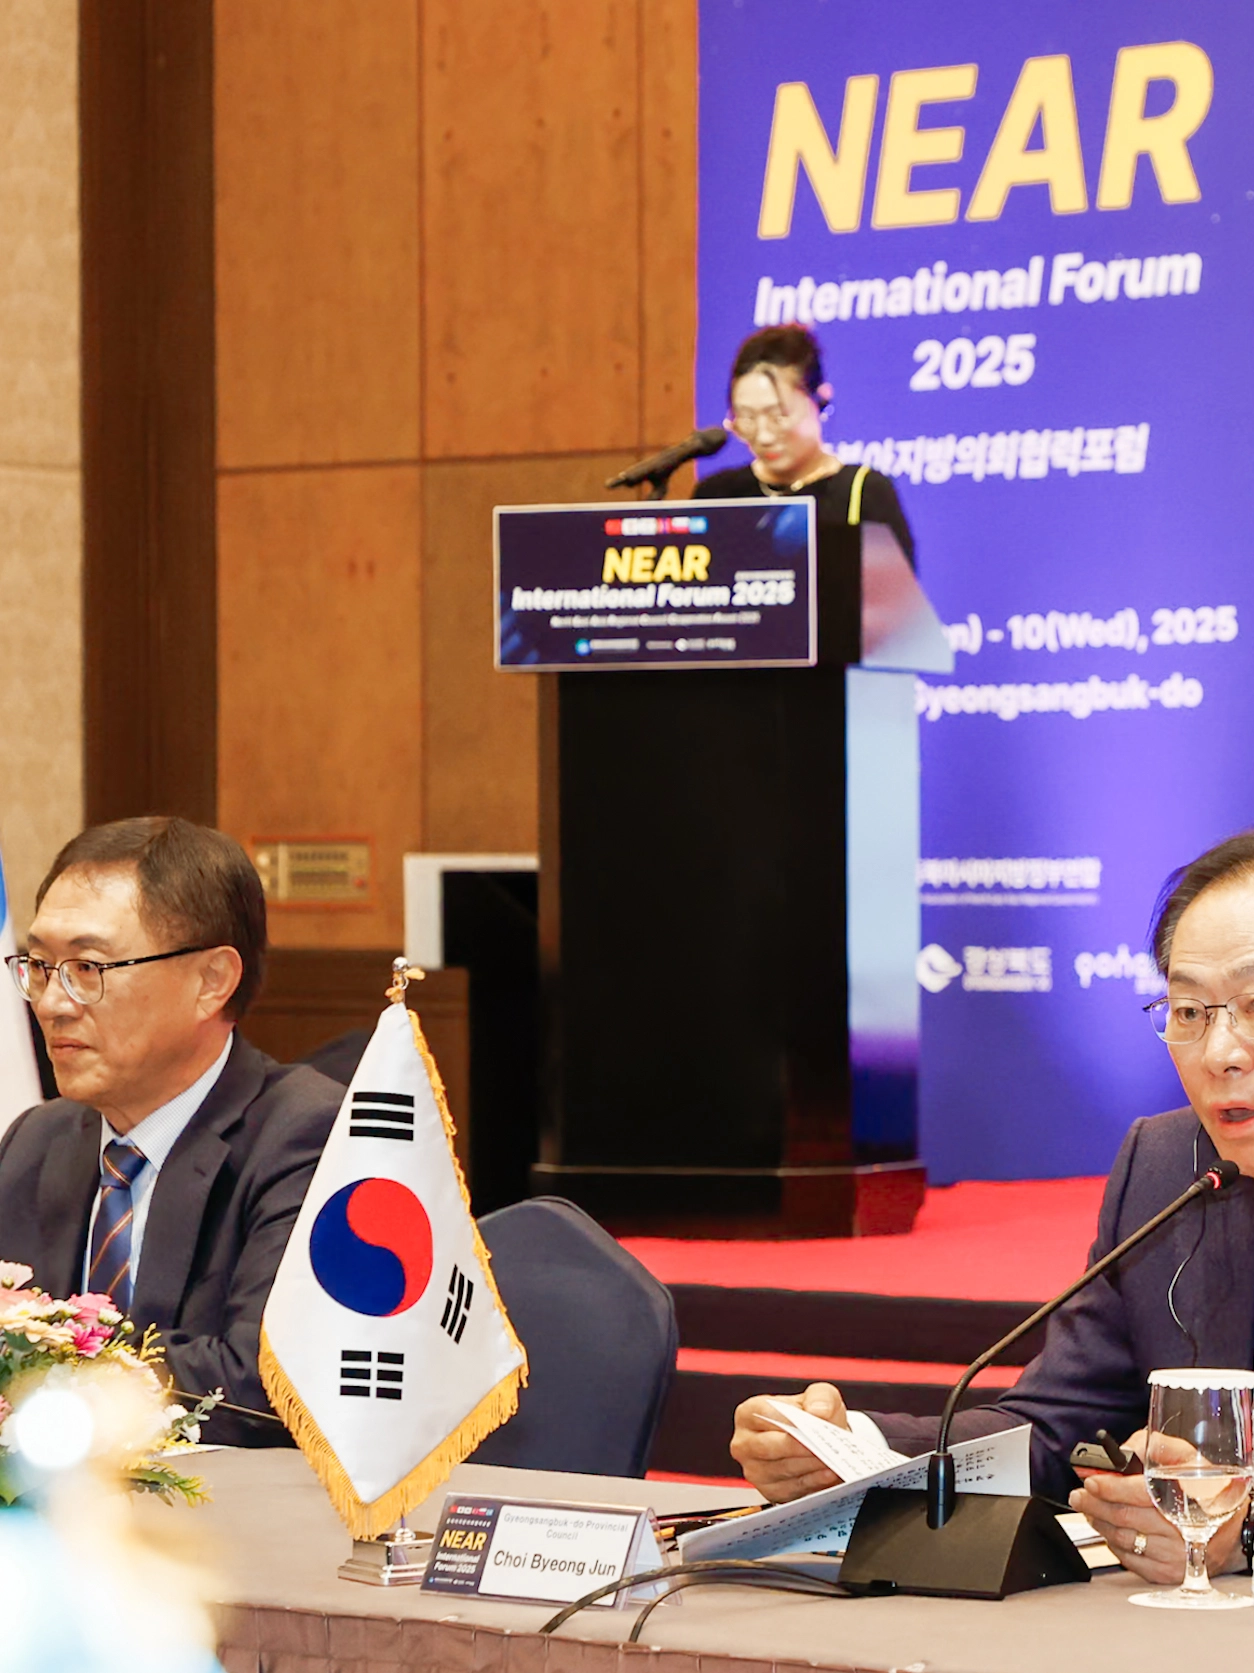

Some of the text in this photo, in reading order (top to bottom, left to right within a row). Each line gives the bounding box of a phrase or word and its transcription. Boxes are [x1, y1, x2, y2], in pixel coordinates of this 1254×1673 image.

[757, 40, 1214, 240] NEAR
[753, 252, 1202, 326] International Forum
[909, 333, 1036, 392] 2025
[602, 545, 711, 583] NEAR
[511, 580, 795, 611] International Forum 2025
[1151, 605, 1238, 645] 2025
[439, 1529, 487, 1551] NEAR
[546, 1529, 578, 1541] Council
[585, 1518, 629, 1533] Provincial
[433, 1561, 477, 1575] Forum 2025
[435, 1551, 481, 1564] International
[493, 1550, 617, 1577] Choi Byeong Jun
